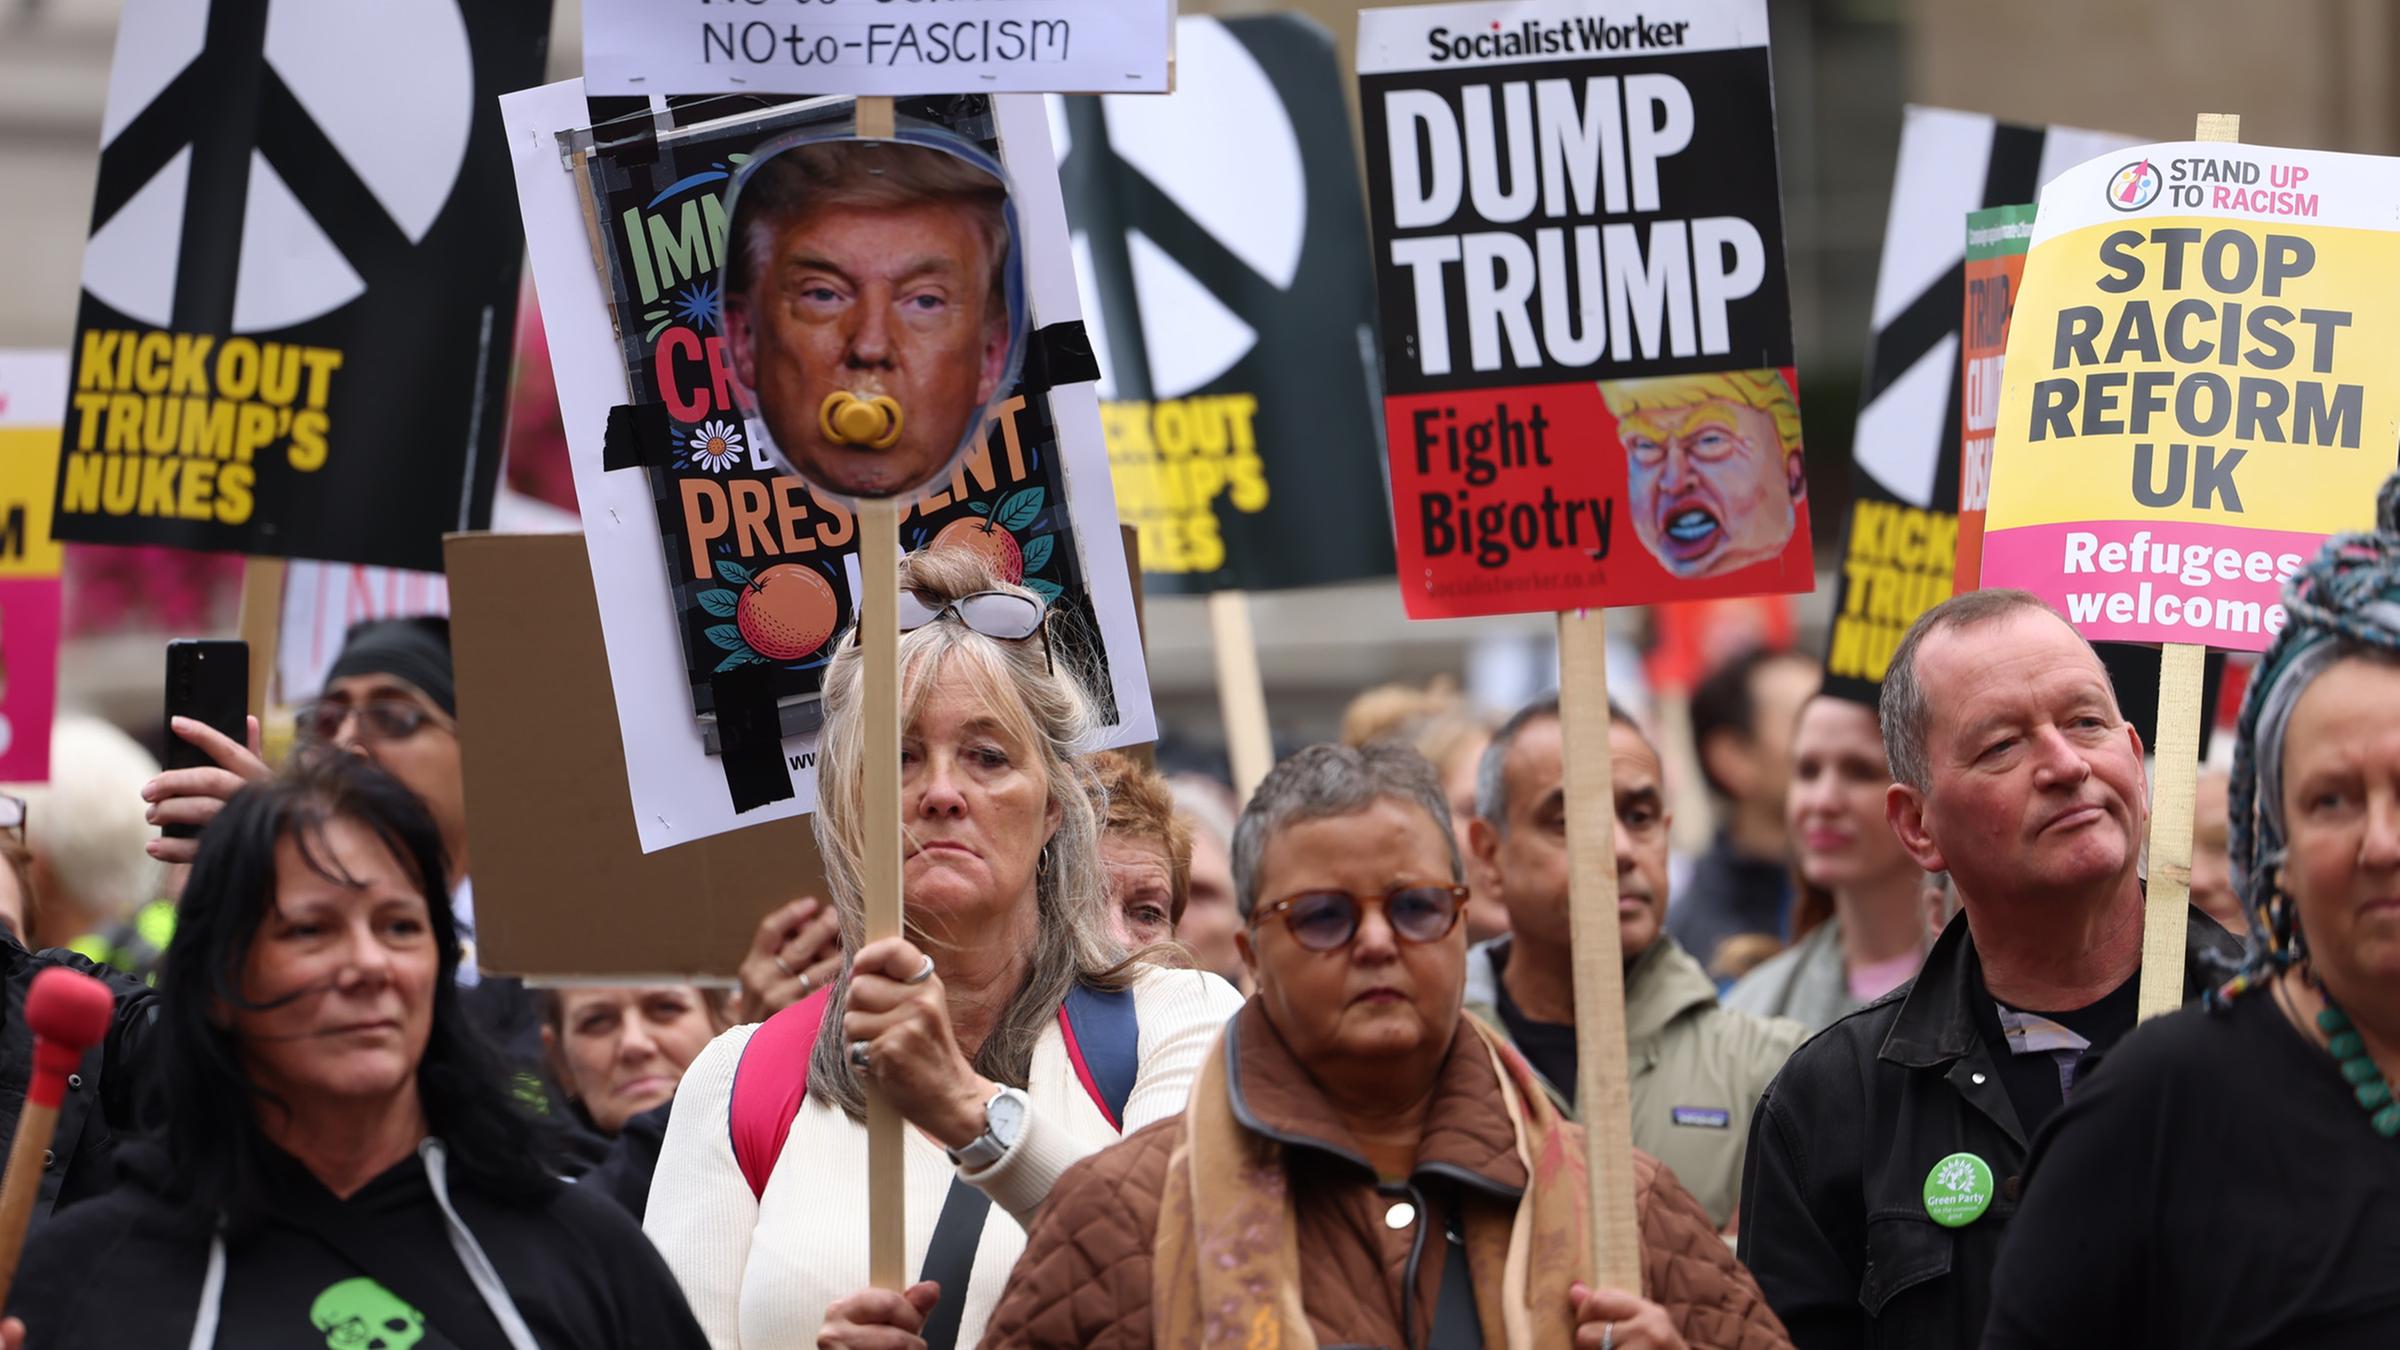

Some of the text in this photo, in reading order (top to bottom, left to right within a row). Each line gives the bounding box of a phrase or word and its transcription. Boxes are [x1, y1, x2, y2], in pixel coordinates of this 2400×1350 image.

[1428, 15, 1690, 62] Socialist Worker
[1384, 72, 1695, 229] DUMP
[2169, 158, 2309, 189] STAND UP
[2168, 184, 2319, 217] TO RACISM
[1390, 216, 1767, 375] TRUMP
[2095, 227, 2316, 298] STOP
[79, 330, 342, 409] KICK OUT
[2052, 298, 2352, 374] RACIST
[74, 393, 331, 471] TRUMP'S
[1154, 392, 1258, 457] OUT
[1413, 403, 1552, 486] Fight
[2027, 371, 2364, 450] REFORM
[63, 452, 255, 524] NUKES
[2131, 443, 2248, 513] UK
[1420, 492, 1614, 569] Bigotry
[2063, 531, 2303, 587] Refugees
[2066, 582, 2289, 636] welcome
[1927, 1193, 1985, 1207] Green Party
